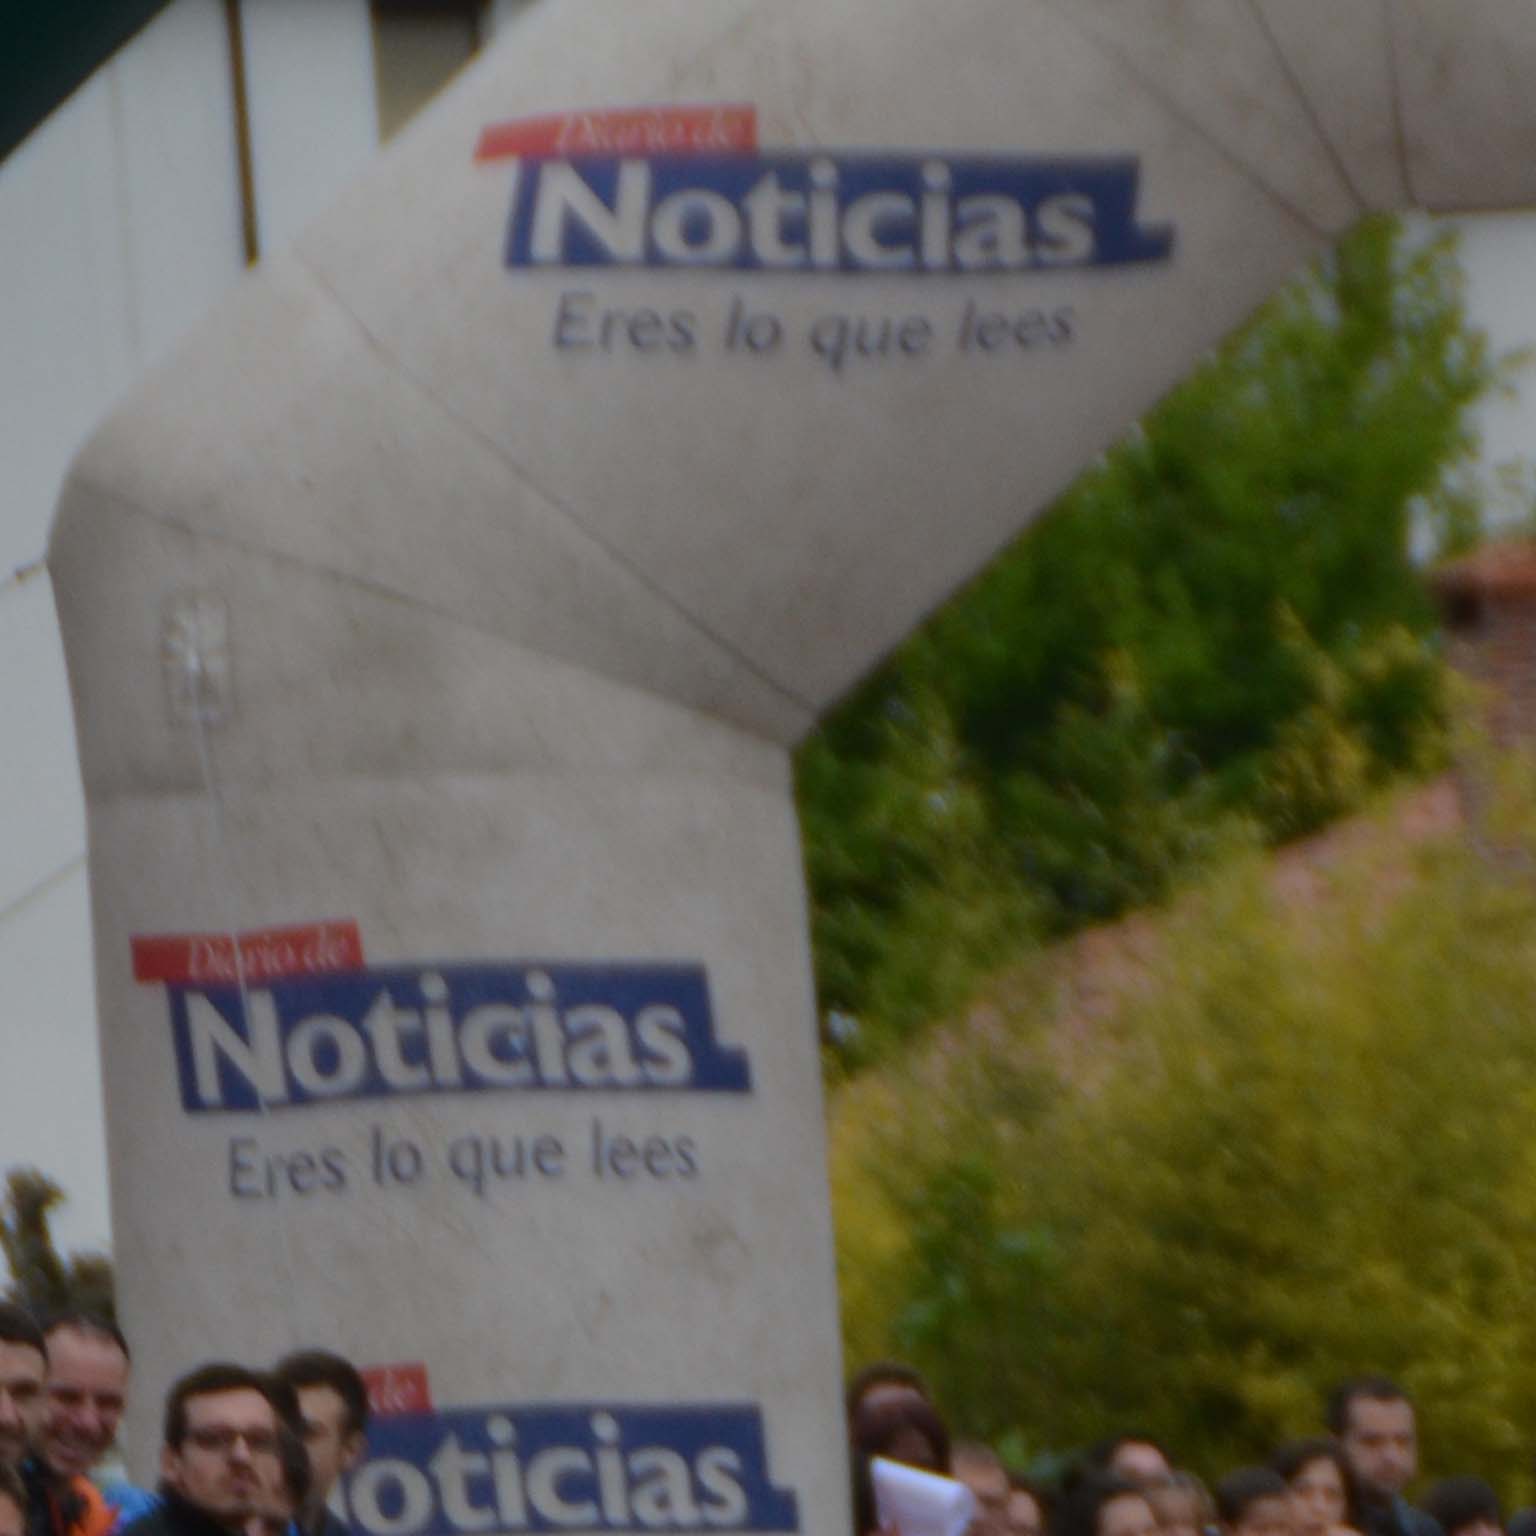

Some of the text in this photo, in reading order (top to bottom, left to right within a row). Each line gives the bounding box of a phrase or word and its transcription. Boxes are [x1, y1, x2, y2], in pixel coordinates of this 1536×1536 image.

[528, 154, 1097, 266] Noticias
[552, 290, 1076, 374] Eres lo que lees
[186, 971, 695, 1105] Noticias
[227, 1117, 698, 1199] Eres lo que lees
